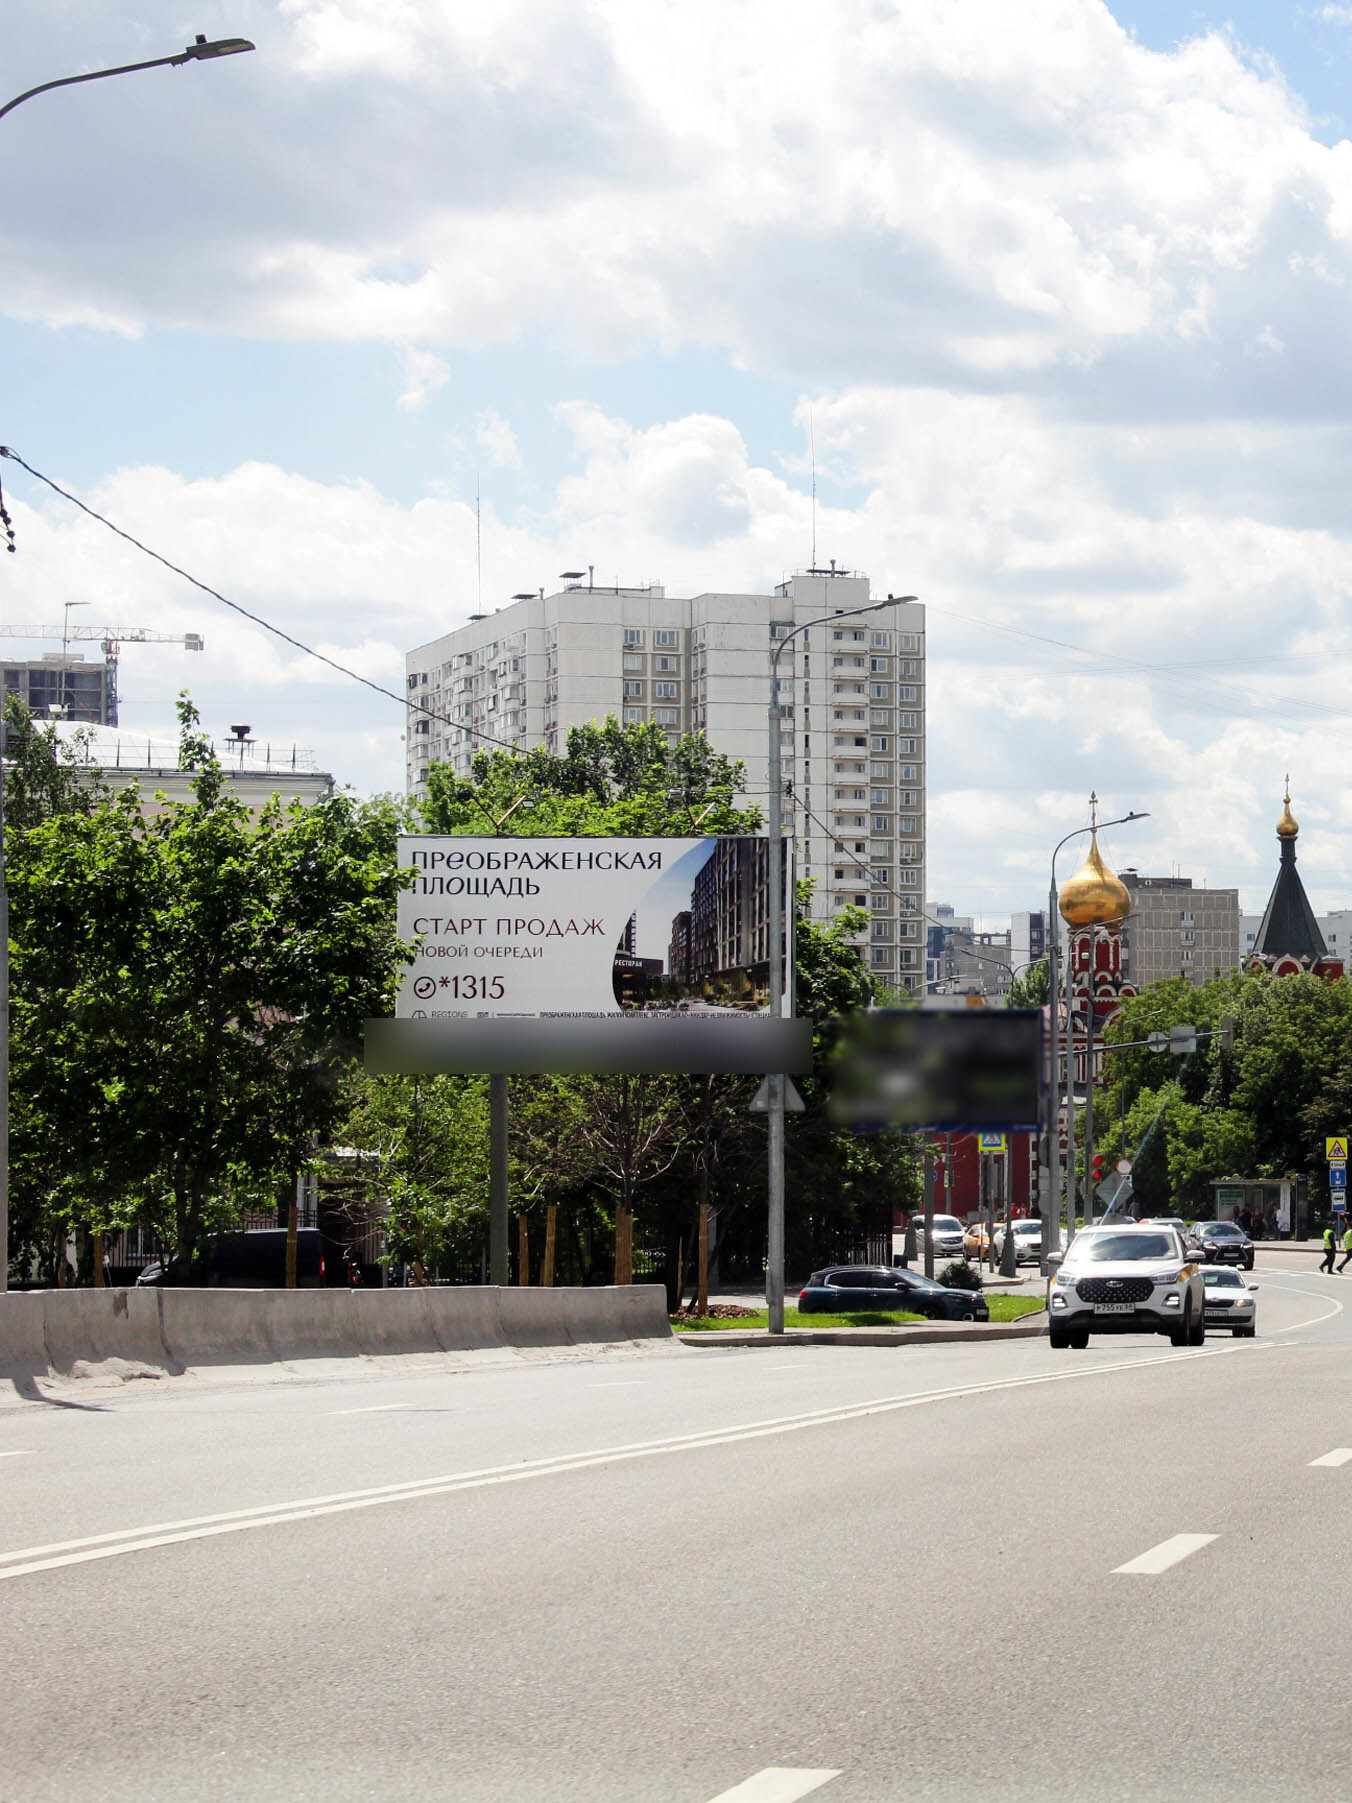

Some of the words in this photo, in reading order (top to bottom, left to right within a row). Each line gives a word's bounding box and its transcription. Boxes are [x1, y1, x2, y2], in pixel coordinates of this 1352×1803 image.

[412, 877, 540, 898] ПЛОЩАДЬ
[413, 918, 488, 935] СТАРТ
[497, 918, 606, 937] ПРОДАЖ
[415, 944, 468, 958] НОВОЙ
[474, 946, 543, 959] ОЧЕРЕДИ
